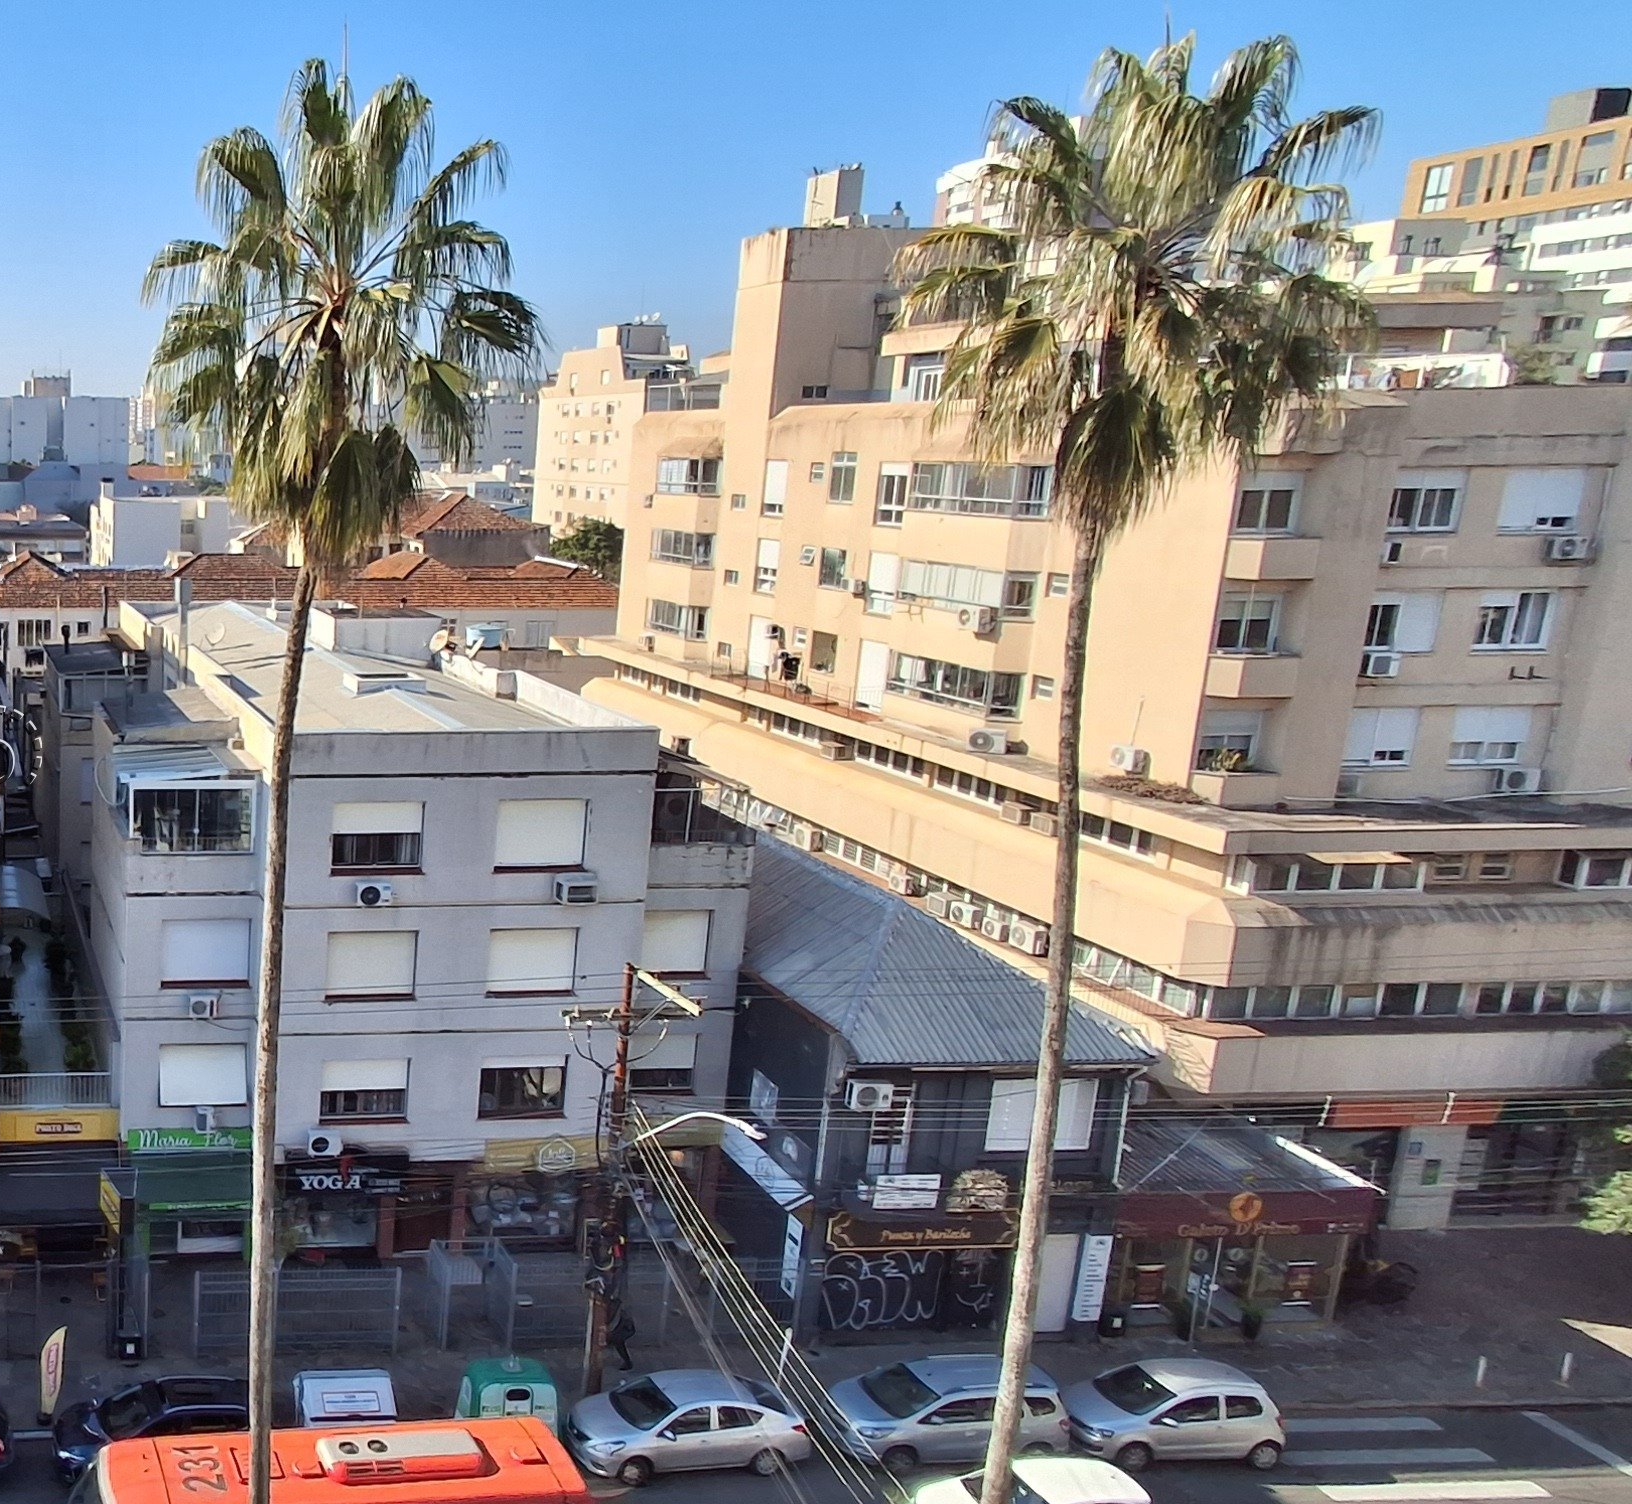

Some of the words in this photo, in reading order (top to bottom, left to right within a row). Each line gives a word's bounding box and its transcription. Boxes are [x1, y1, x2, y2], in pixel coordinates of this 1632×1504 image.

[139, 1130, 193, 1148] Maria
[299, 1174, 362, 1191] YOGA
[172, 1444, 228, 1492] 231
